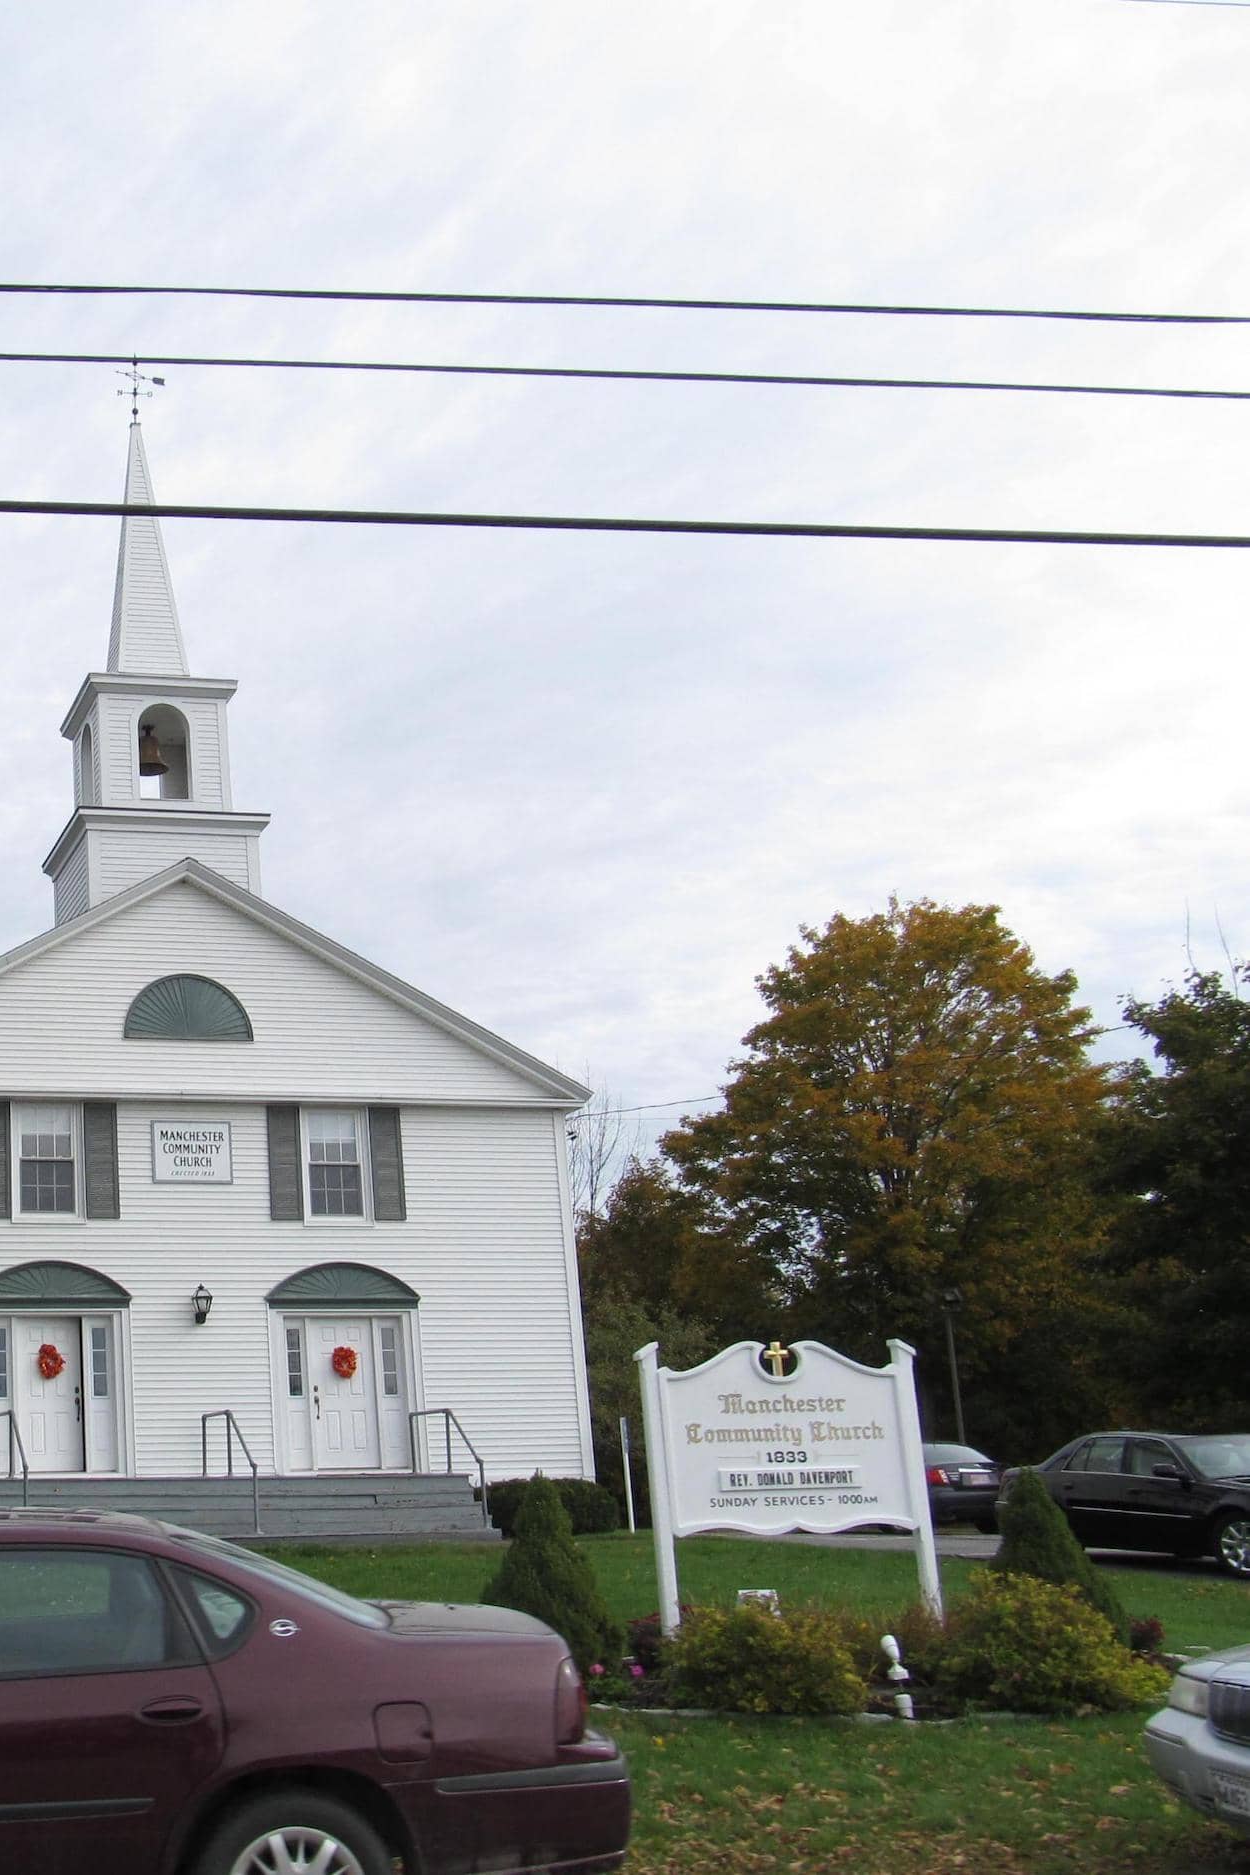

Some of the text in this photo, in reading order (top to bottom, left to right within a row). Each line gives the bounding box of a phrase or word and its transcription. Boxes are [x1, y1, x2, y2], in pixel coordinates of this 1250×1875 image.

[159, 1130, 224, 1142] MANCHESTER
[163, 1142, 221, 1154] COMMUNITY
[173, 1155, 212, 1167] CHURCH
[718, 1393, 846, 1414] Manchester
[685, 1419, 885, 1446] Community Church
[766, 1450, 808, 1463] 1833
[729, 1470, 854, 1487] REV. DONALD DAVENPORT
[710, 1497, 758, 1508] SUNDAY
[764, 1495, 825, 1507] SERVICES
